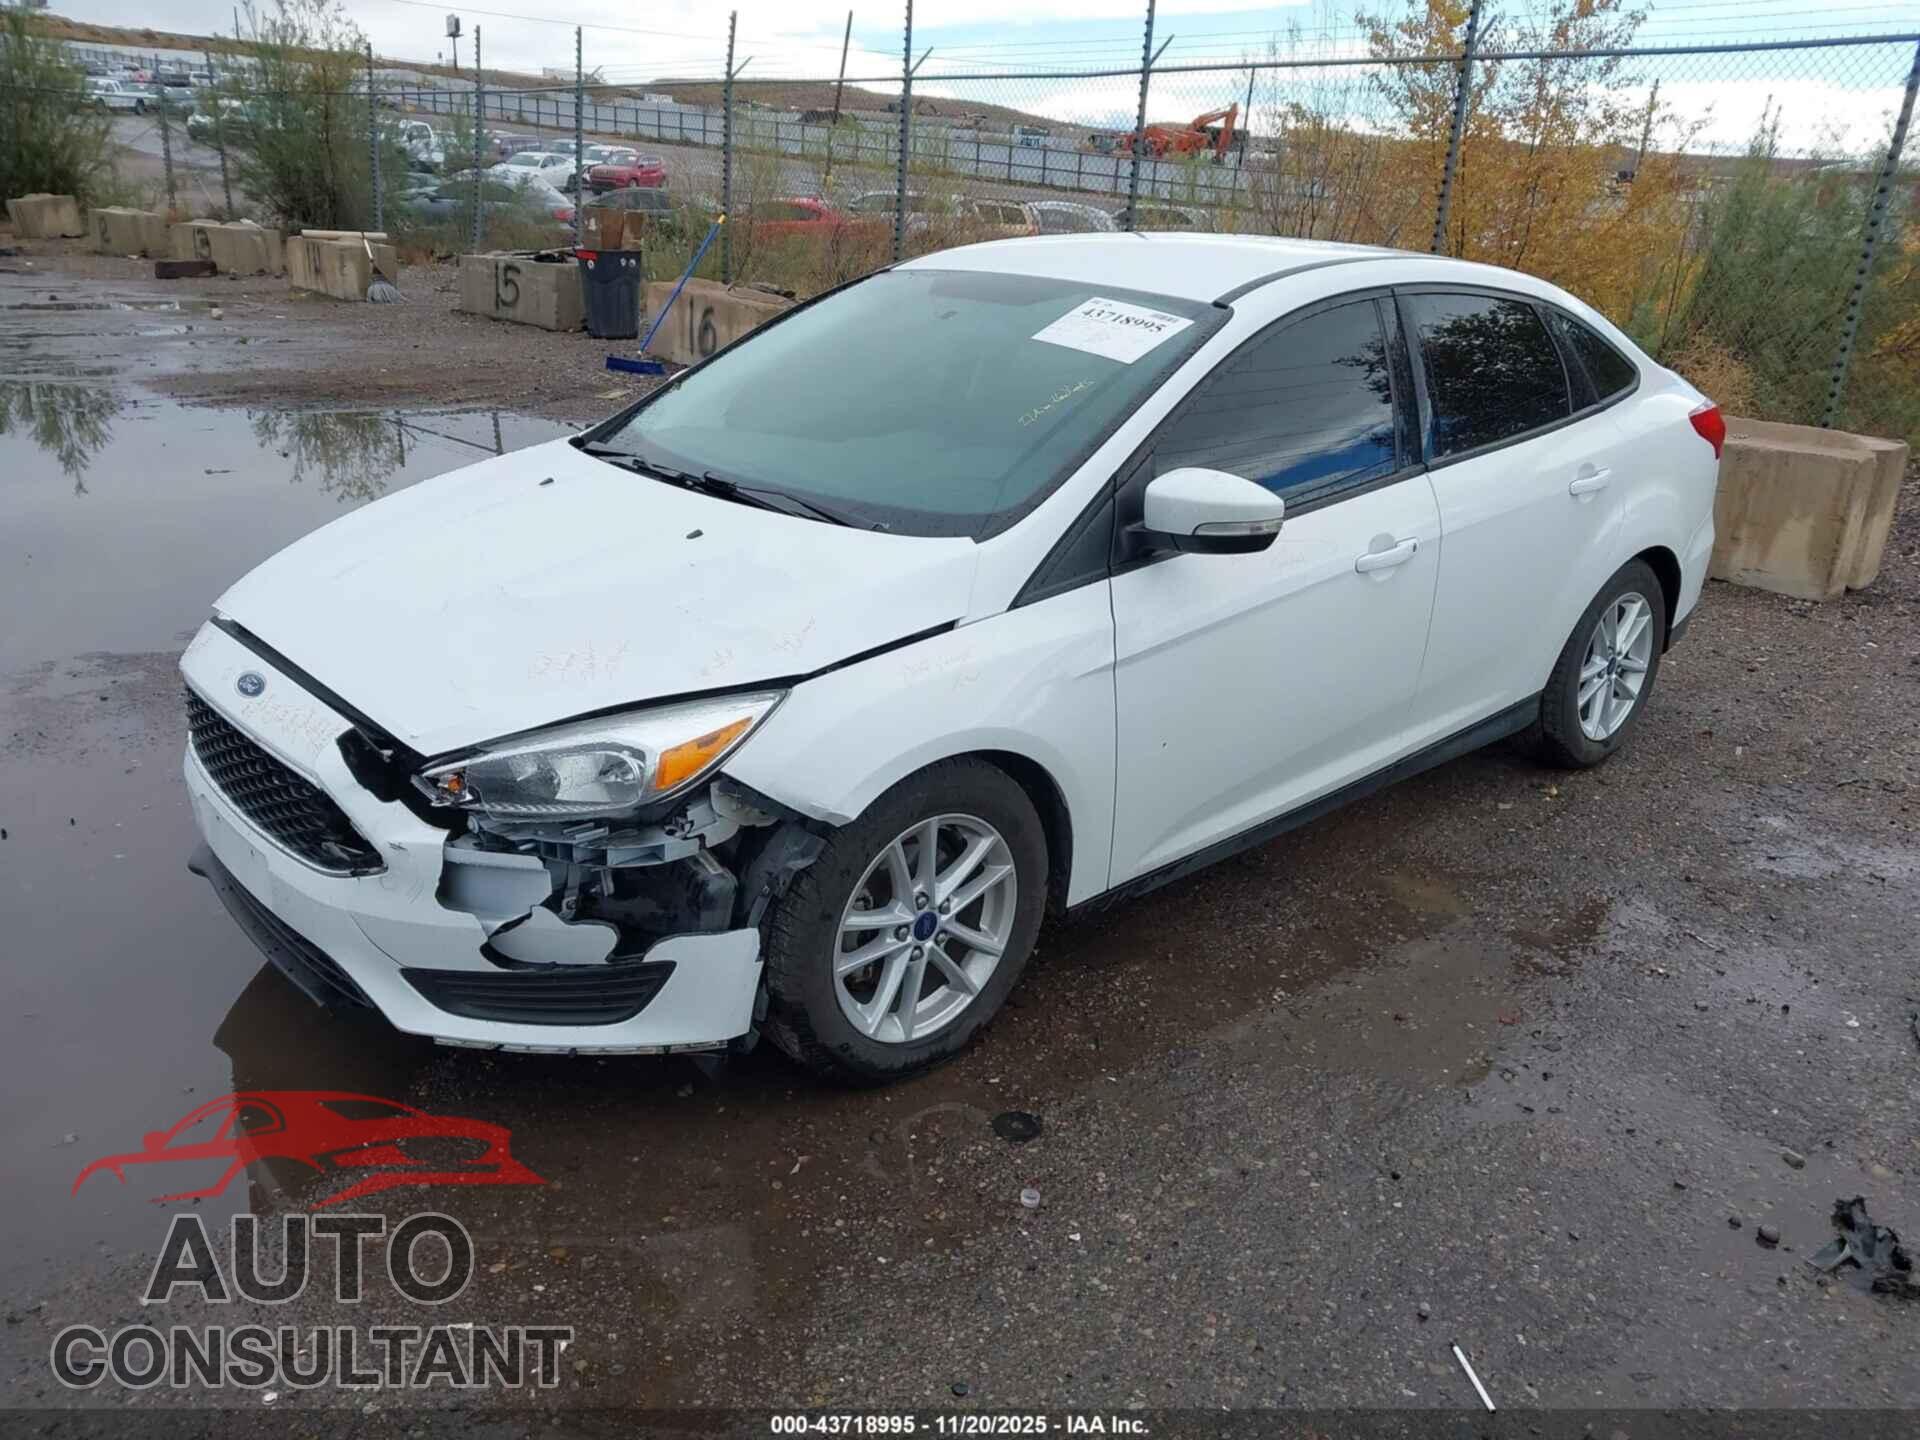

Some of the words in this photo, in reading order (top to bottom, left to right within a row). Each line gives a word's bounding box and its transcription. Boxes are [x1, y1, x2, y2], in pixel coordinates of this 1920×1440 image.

[495, 261, 521, 309] 15
[689, 296, 717, 354] 16
[1081, 307, 1167, 333] 43718995
